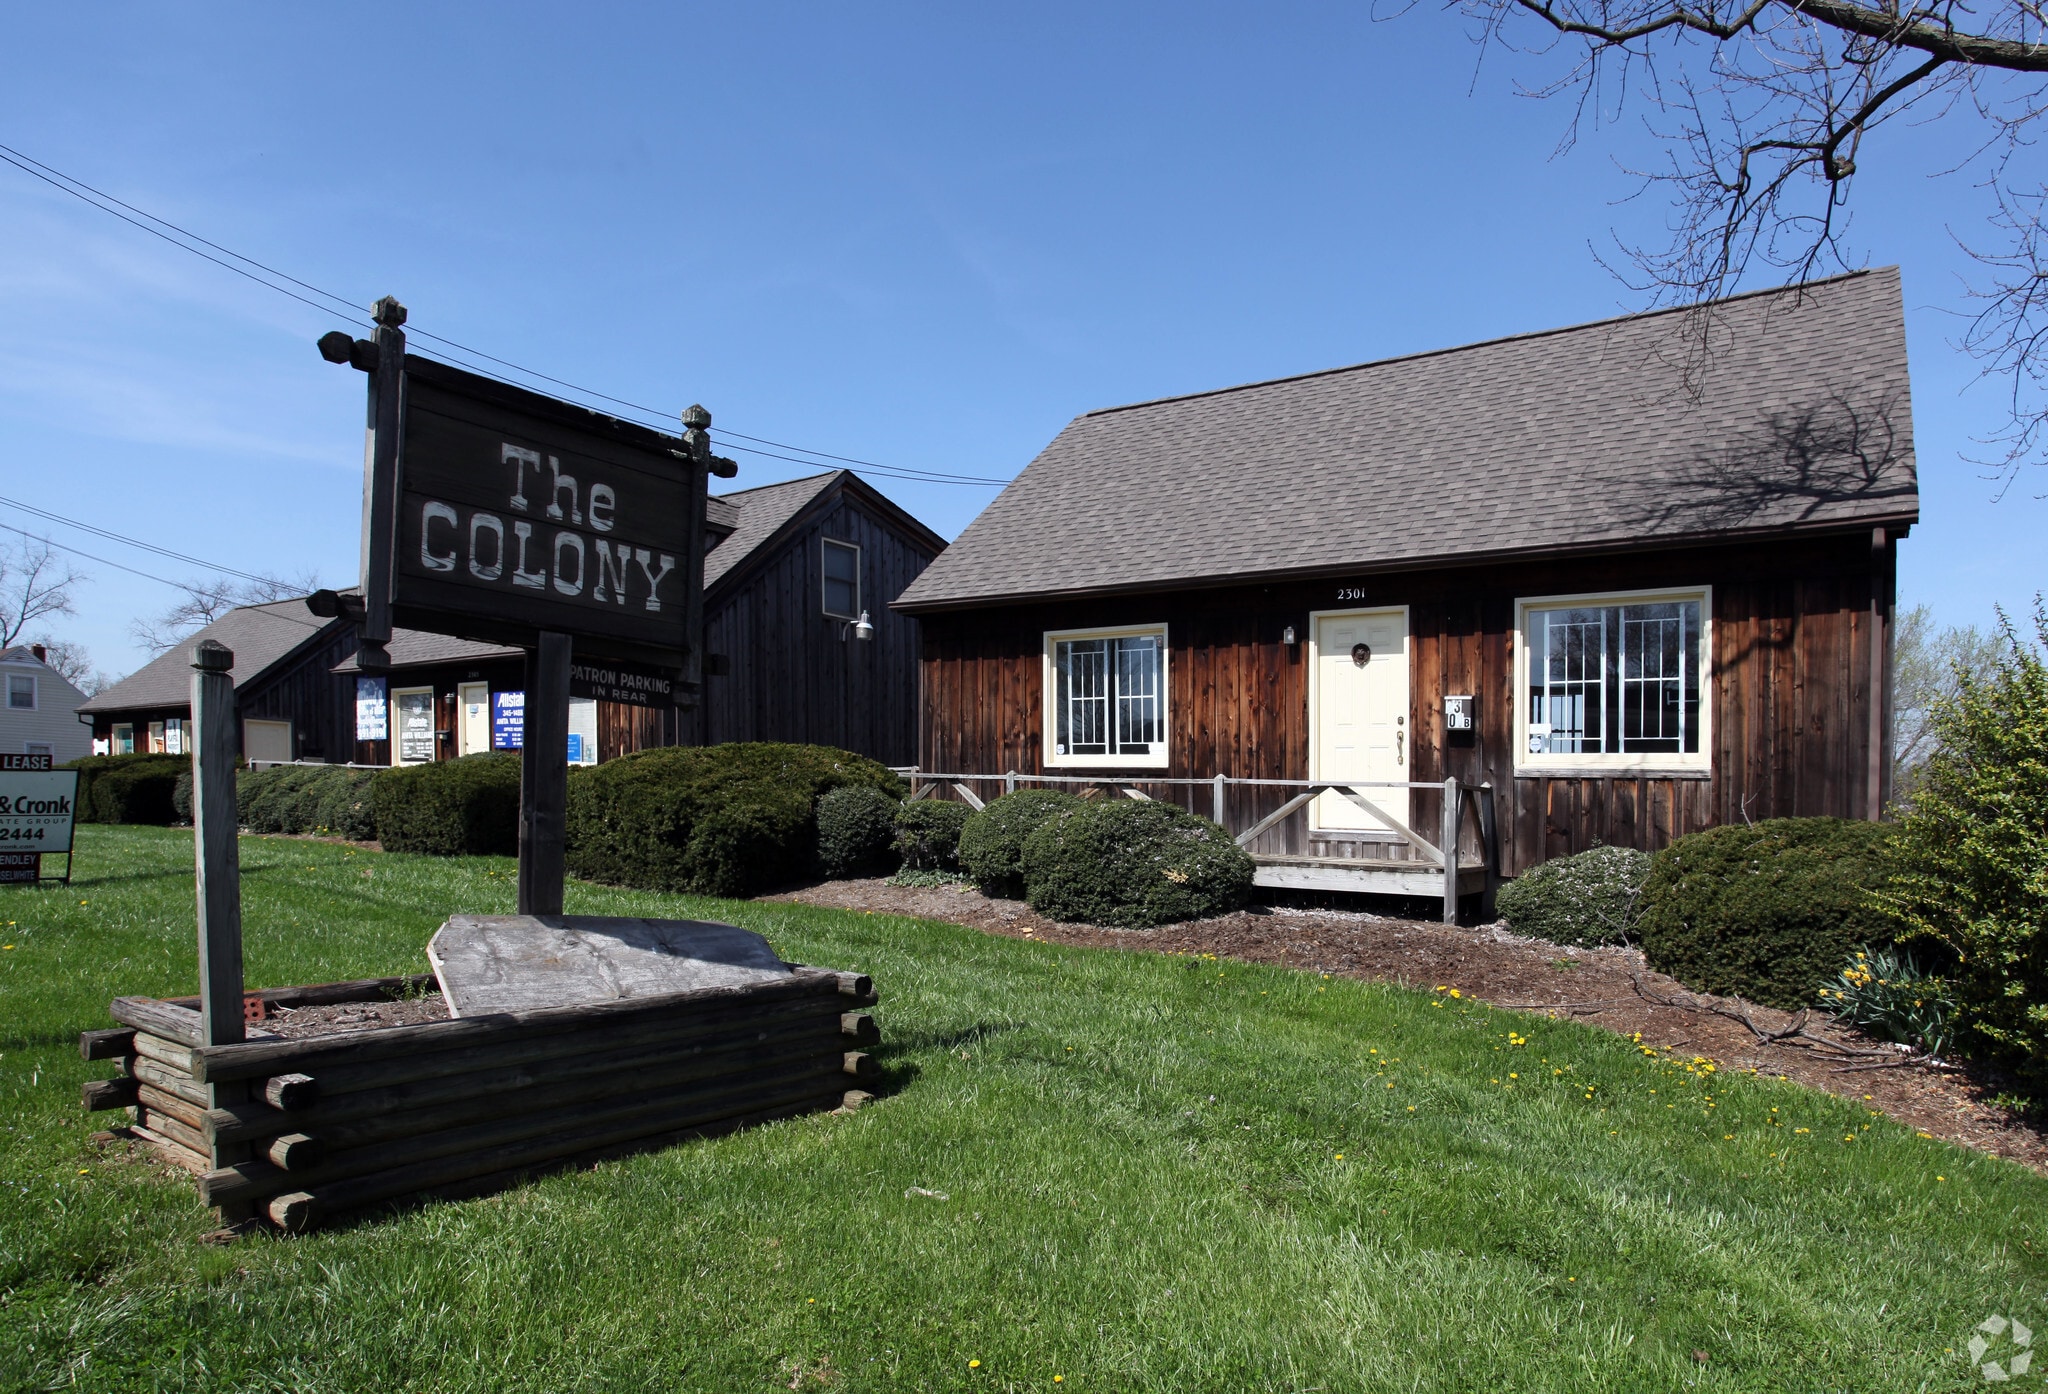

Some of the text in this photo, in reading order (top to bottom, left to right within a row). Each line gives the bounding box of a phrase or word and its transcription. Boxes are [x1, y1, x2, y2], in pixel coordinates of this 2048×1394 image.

[501, 442, 616, 532] The
[421, 501, 675, 613] COLONY
[1337, 587, 1366, 600] 2301
[570, 665, 671, 695] PATRON PARKING
[592, 685, 648, 704] IN REAR
[4, 756, 49, 770] LEASE
[14, 795, 71, 814] Cronk
[0, 828, 45, 841] 2444
[0, 855, 36, 865] ENDLEY
[0, 870, 35, 881] SELWHITE
